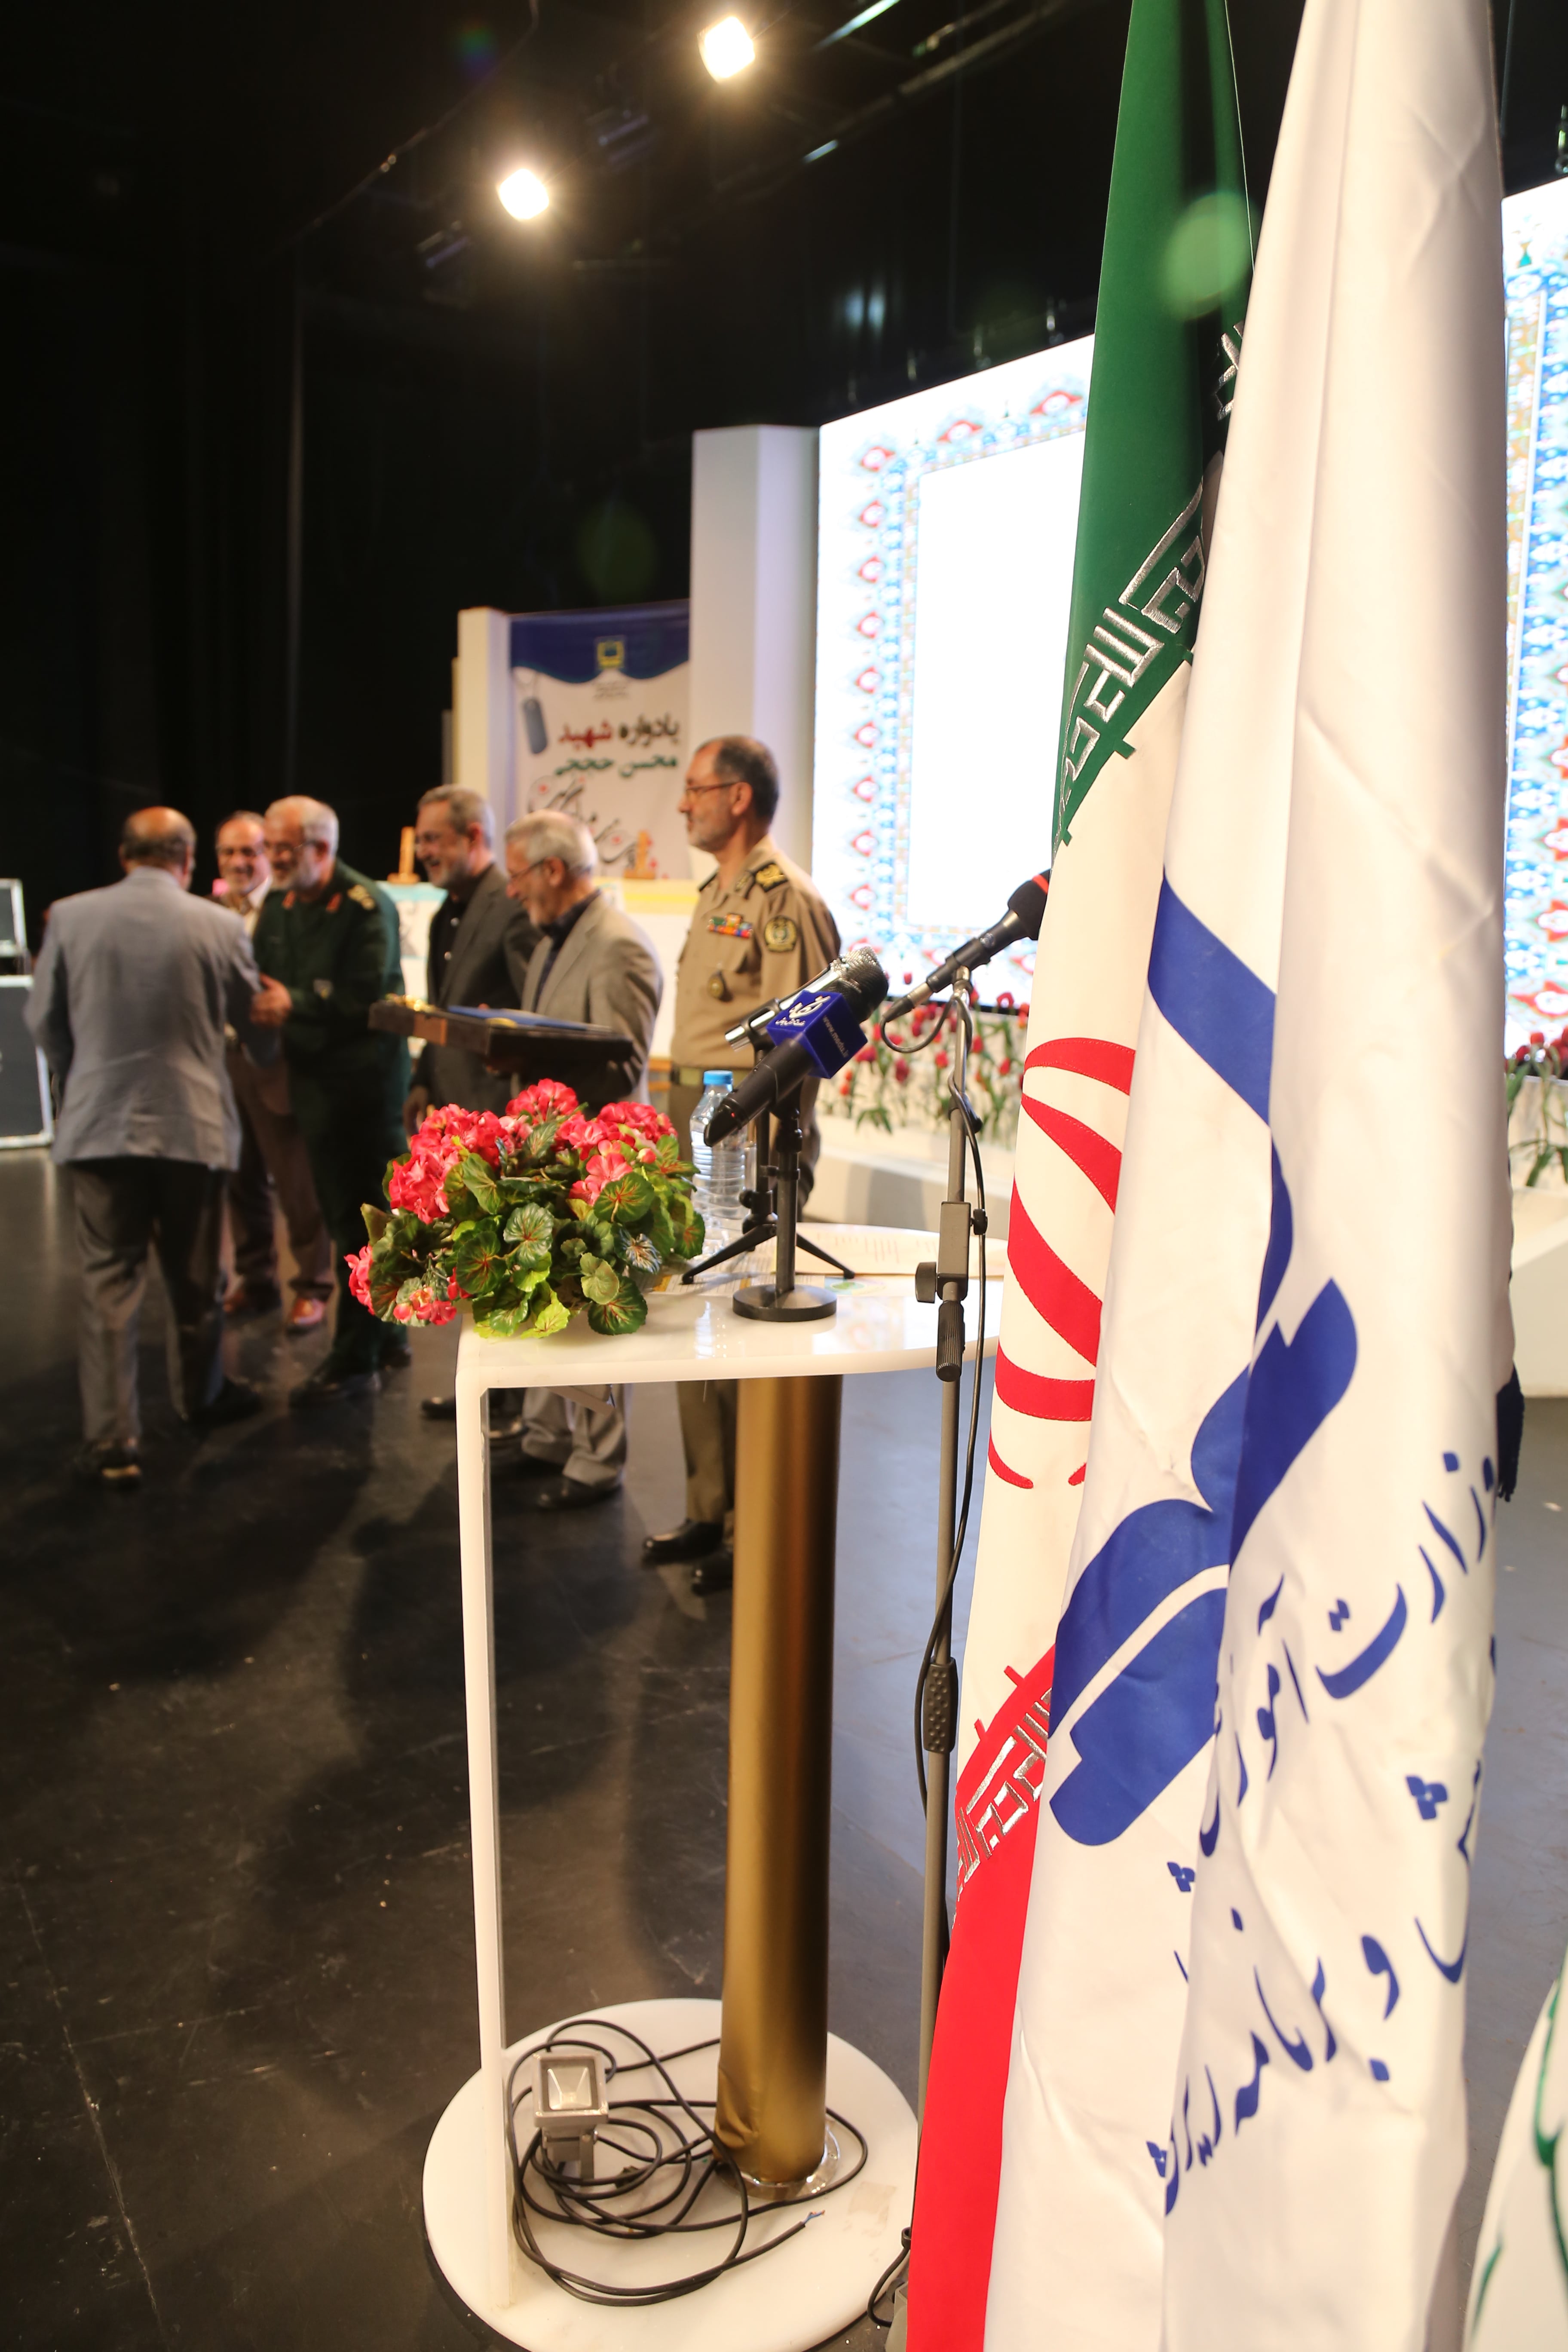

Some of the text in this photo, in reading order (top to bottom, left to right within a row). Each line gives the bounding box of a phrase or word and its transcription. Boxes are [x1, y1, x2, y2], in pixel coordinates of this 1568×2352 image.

[558, 711, 680, 750] یادواره شهید
[618, 755, 678, 778] محسن
[822, 1014, 850, 1059] www.medu.ir
